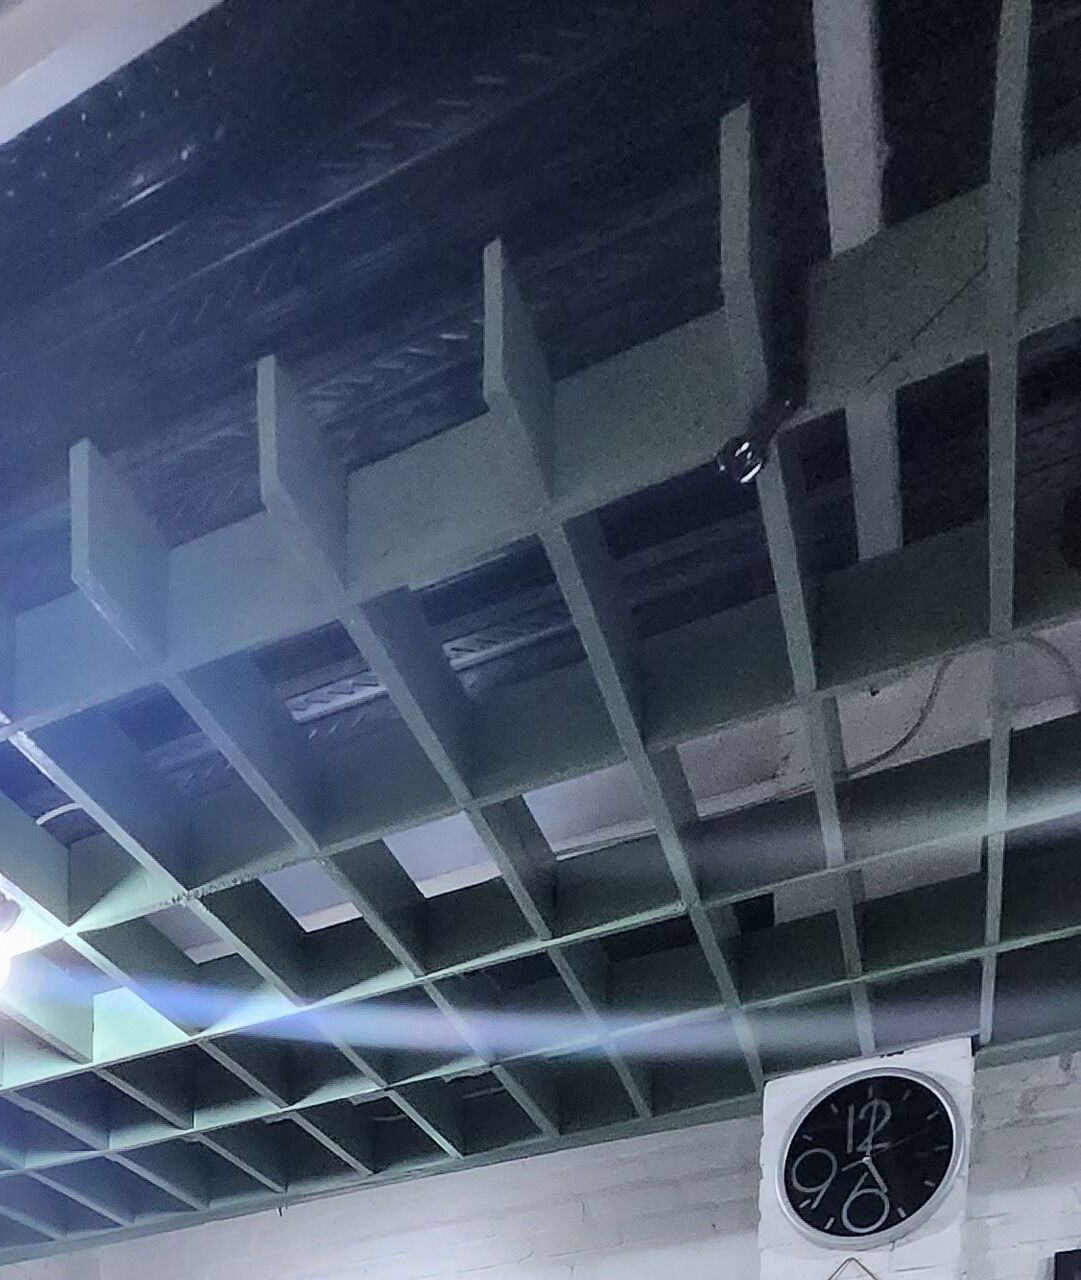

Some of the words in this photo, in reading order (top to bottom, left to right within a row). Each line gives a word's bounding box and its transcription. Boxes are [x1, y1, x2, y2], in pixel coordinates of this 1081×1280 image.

[846, 1097, 892, 1154] 12
[792, 1148, 838, 1210] 9
[841, 1171, 890, 1233] 6
